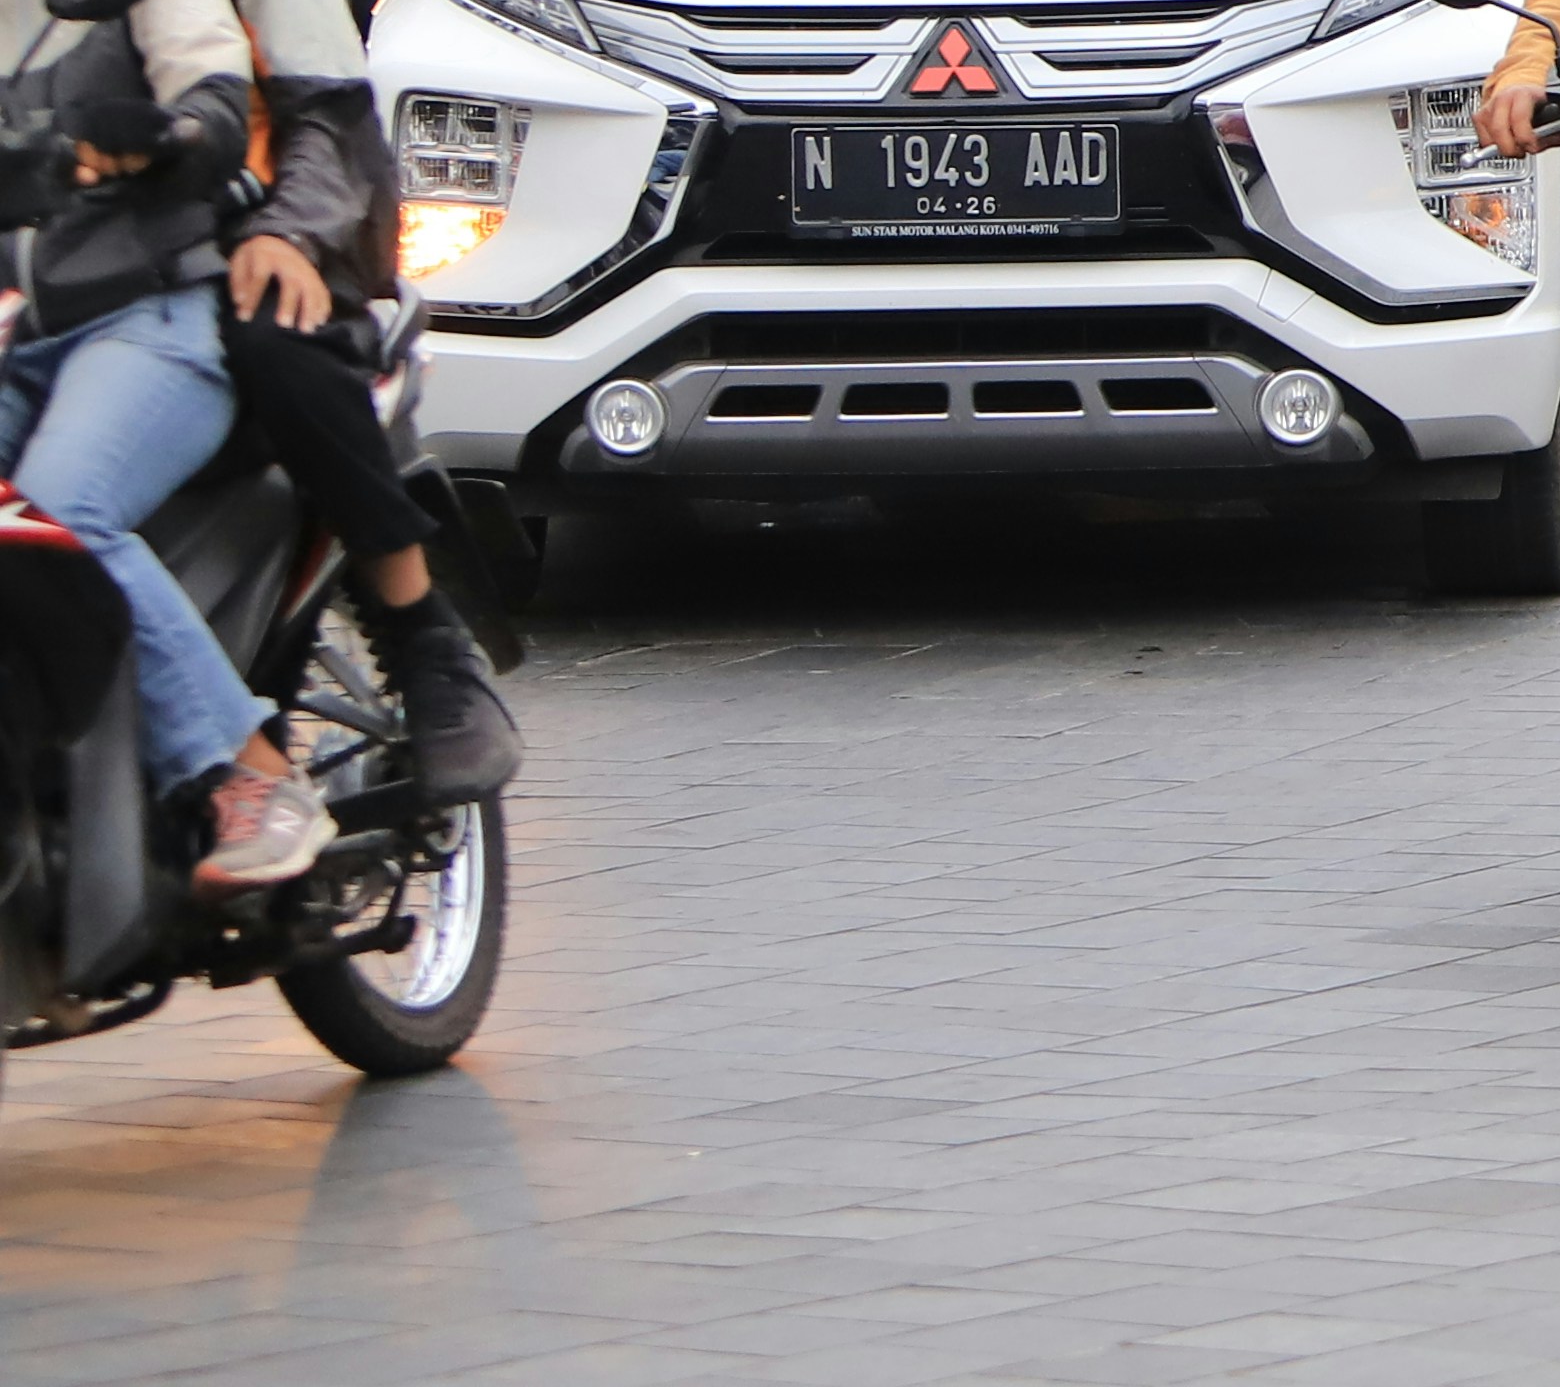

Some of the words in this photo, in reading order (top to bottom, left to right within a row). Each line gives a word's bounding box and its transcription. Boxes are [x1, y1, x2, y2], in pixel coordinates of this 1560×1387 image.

[804, 136, 832, 189] N
[881, 133, 990, 188] 1943
[1024, 131, 1107, 186] AAD
[852, 226, 872, 237] SUN
[874, 226, 898, 237] STAR
[900, 225, 934, 237] MOTOR
[936, 225, 978, 236] MALANG
[980, 224, 1006, 235] KOTA
[1007, 223, 1059, 235] 0341-493716
